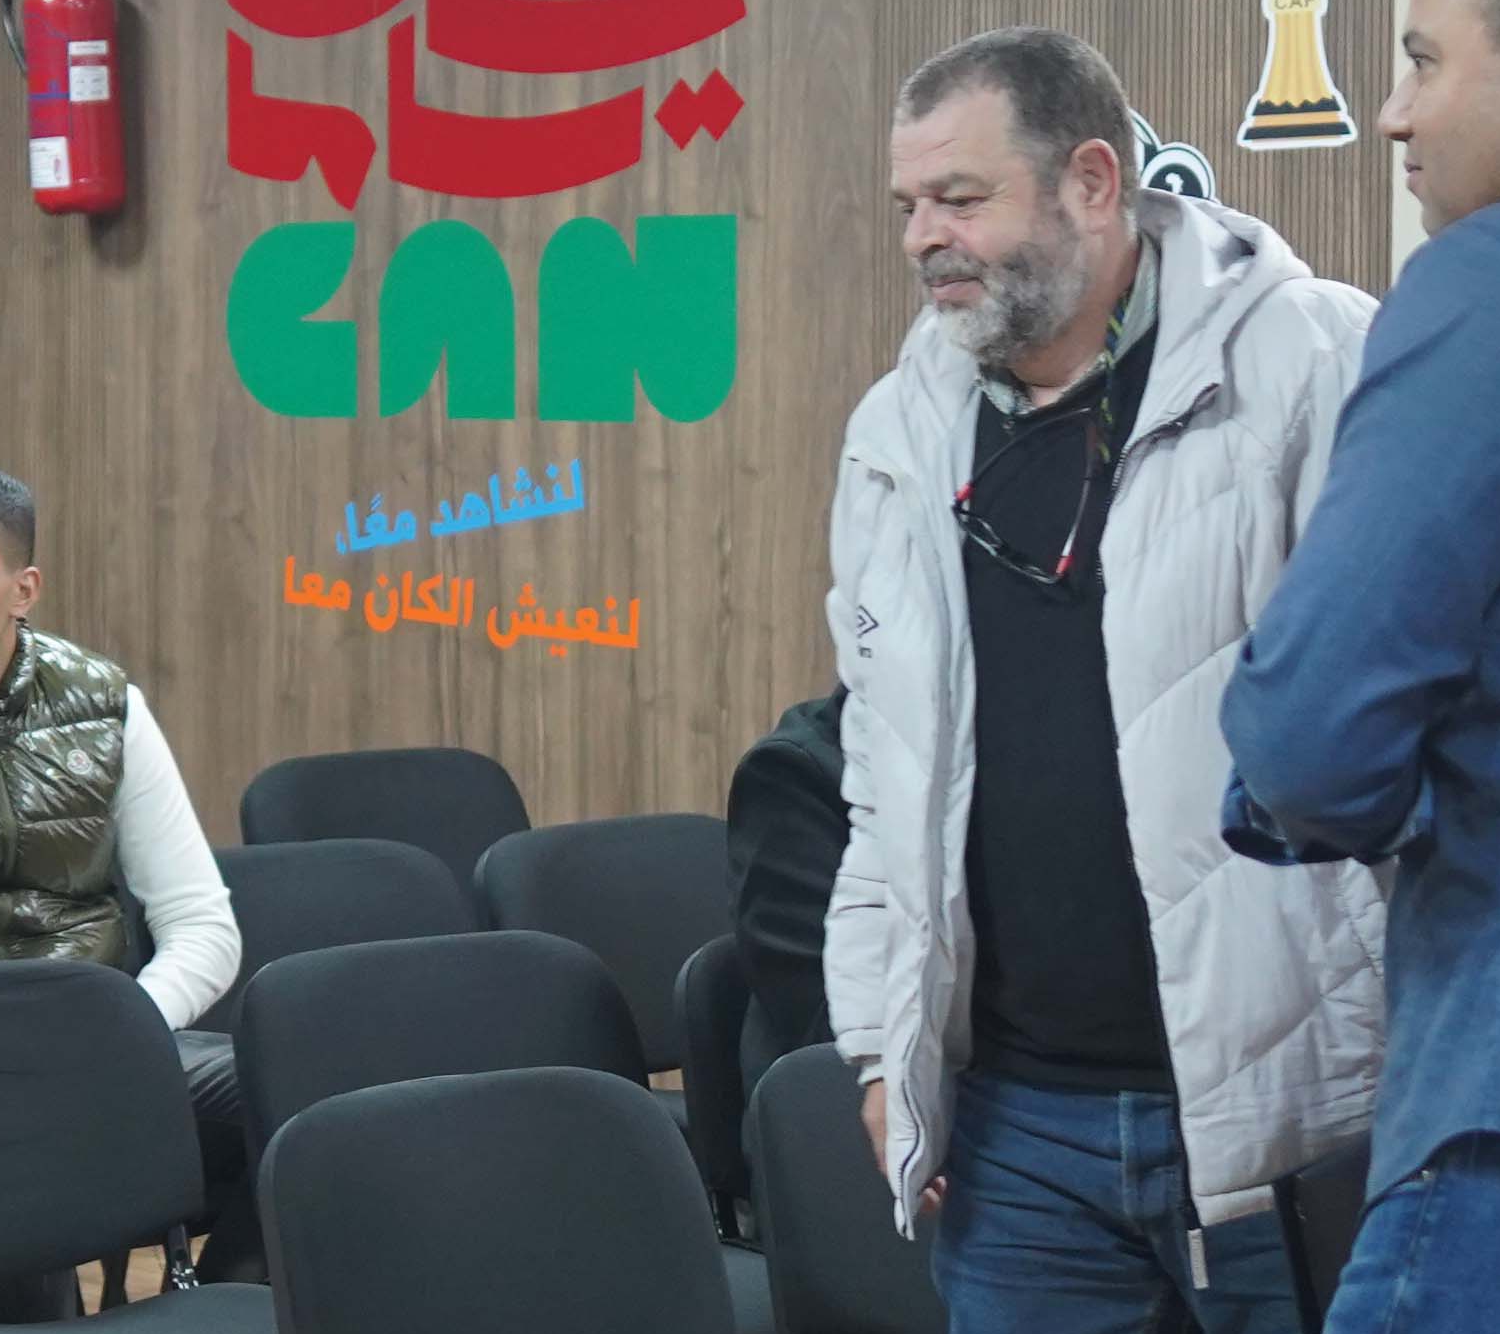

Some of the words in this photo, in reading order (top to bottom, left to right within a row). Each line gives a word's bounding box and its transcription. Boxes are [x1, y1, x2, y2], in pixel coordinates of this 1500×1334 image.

[226, 213, 738, 424] CAN
[429, 458, 586, 539] لنشاهد
[283, 555, 353, 612] معا
[363, 570, 475, 633] الكان
[485, 583, 641, 660] لنعيش
